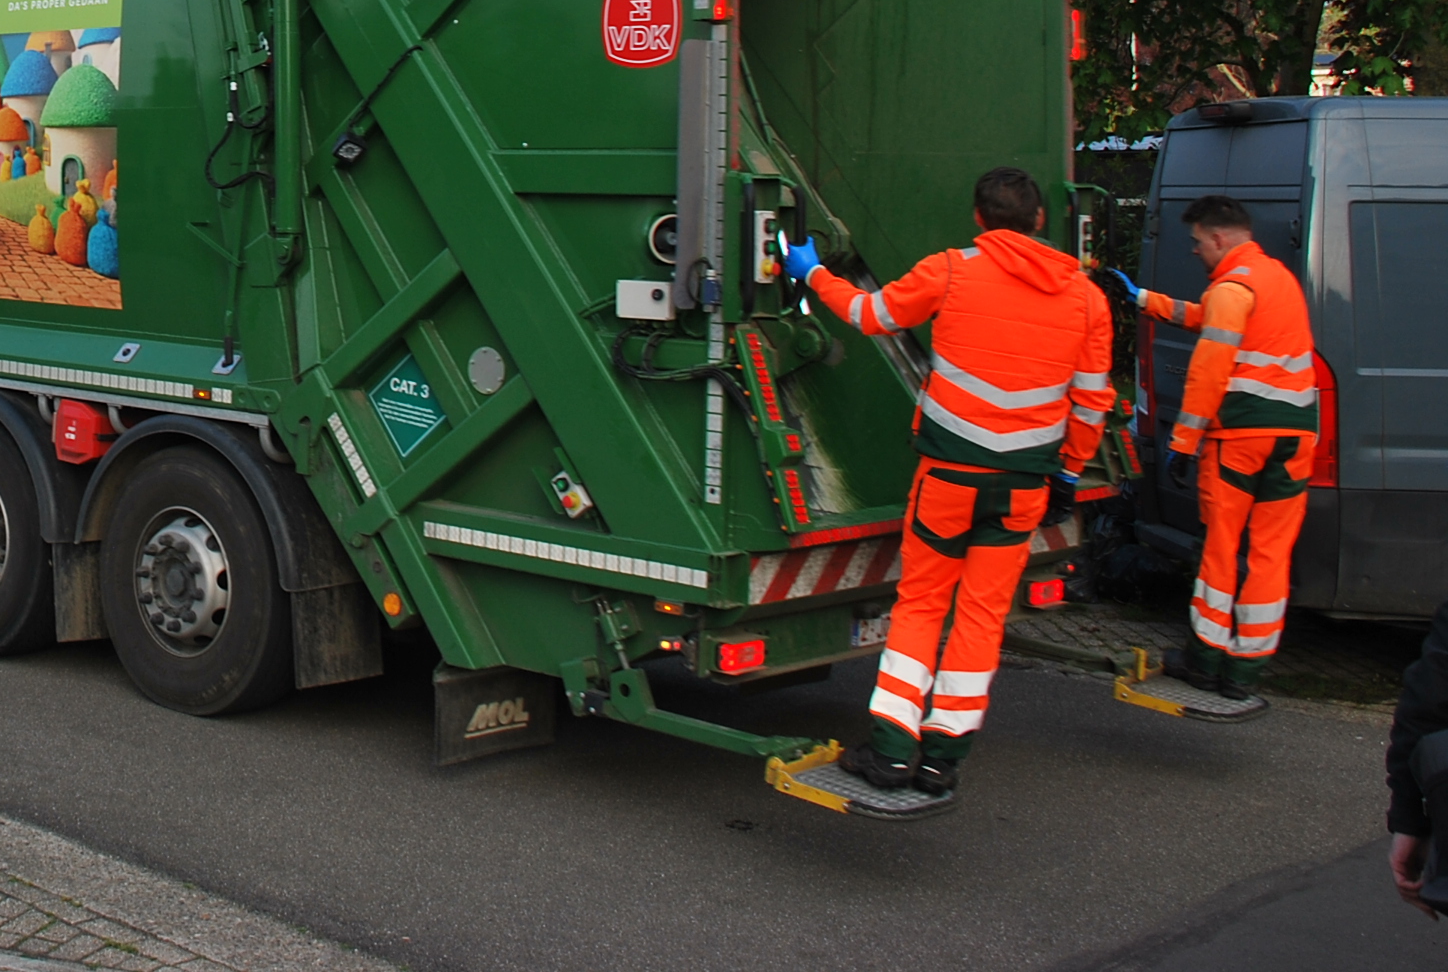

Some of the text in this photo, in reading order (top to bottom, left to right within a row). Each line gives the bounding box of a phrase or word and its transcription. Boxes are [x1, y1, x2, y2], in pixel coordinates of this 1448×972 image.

[8, 0, 28, 12] DA'S
[608, 24, 671, 51] VDK
[389, 377, 430, 399] CAT. 3
[466, 696, 530, 732] MOL
